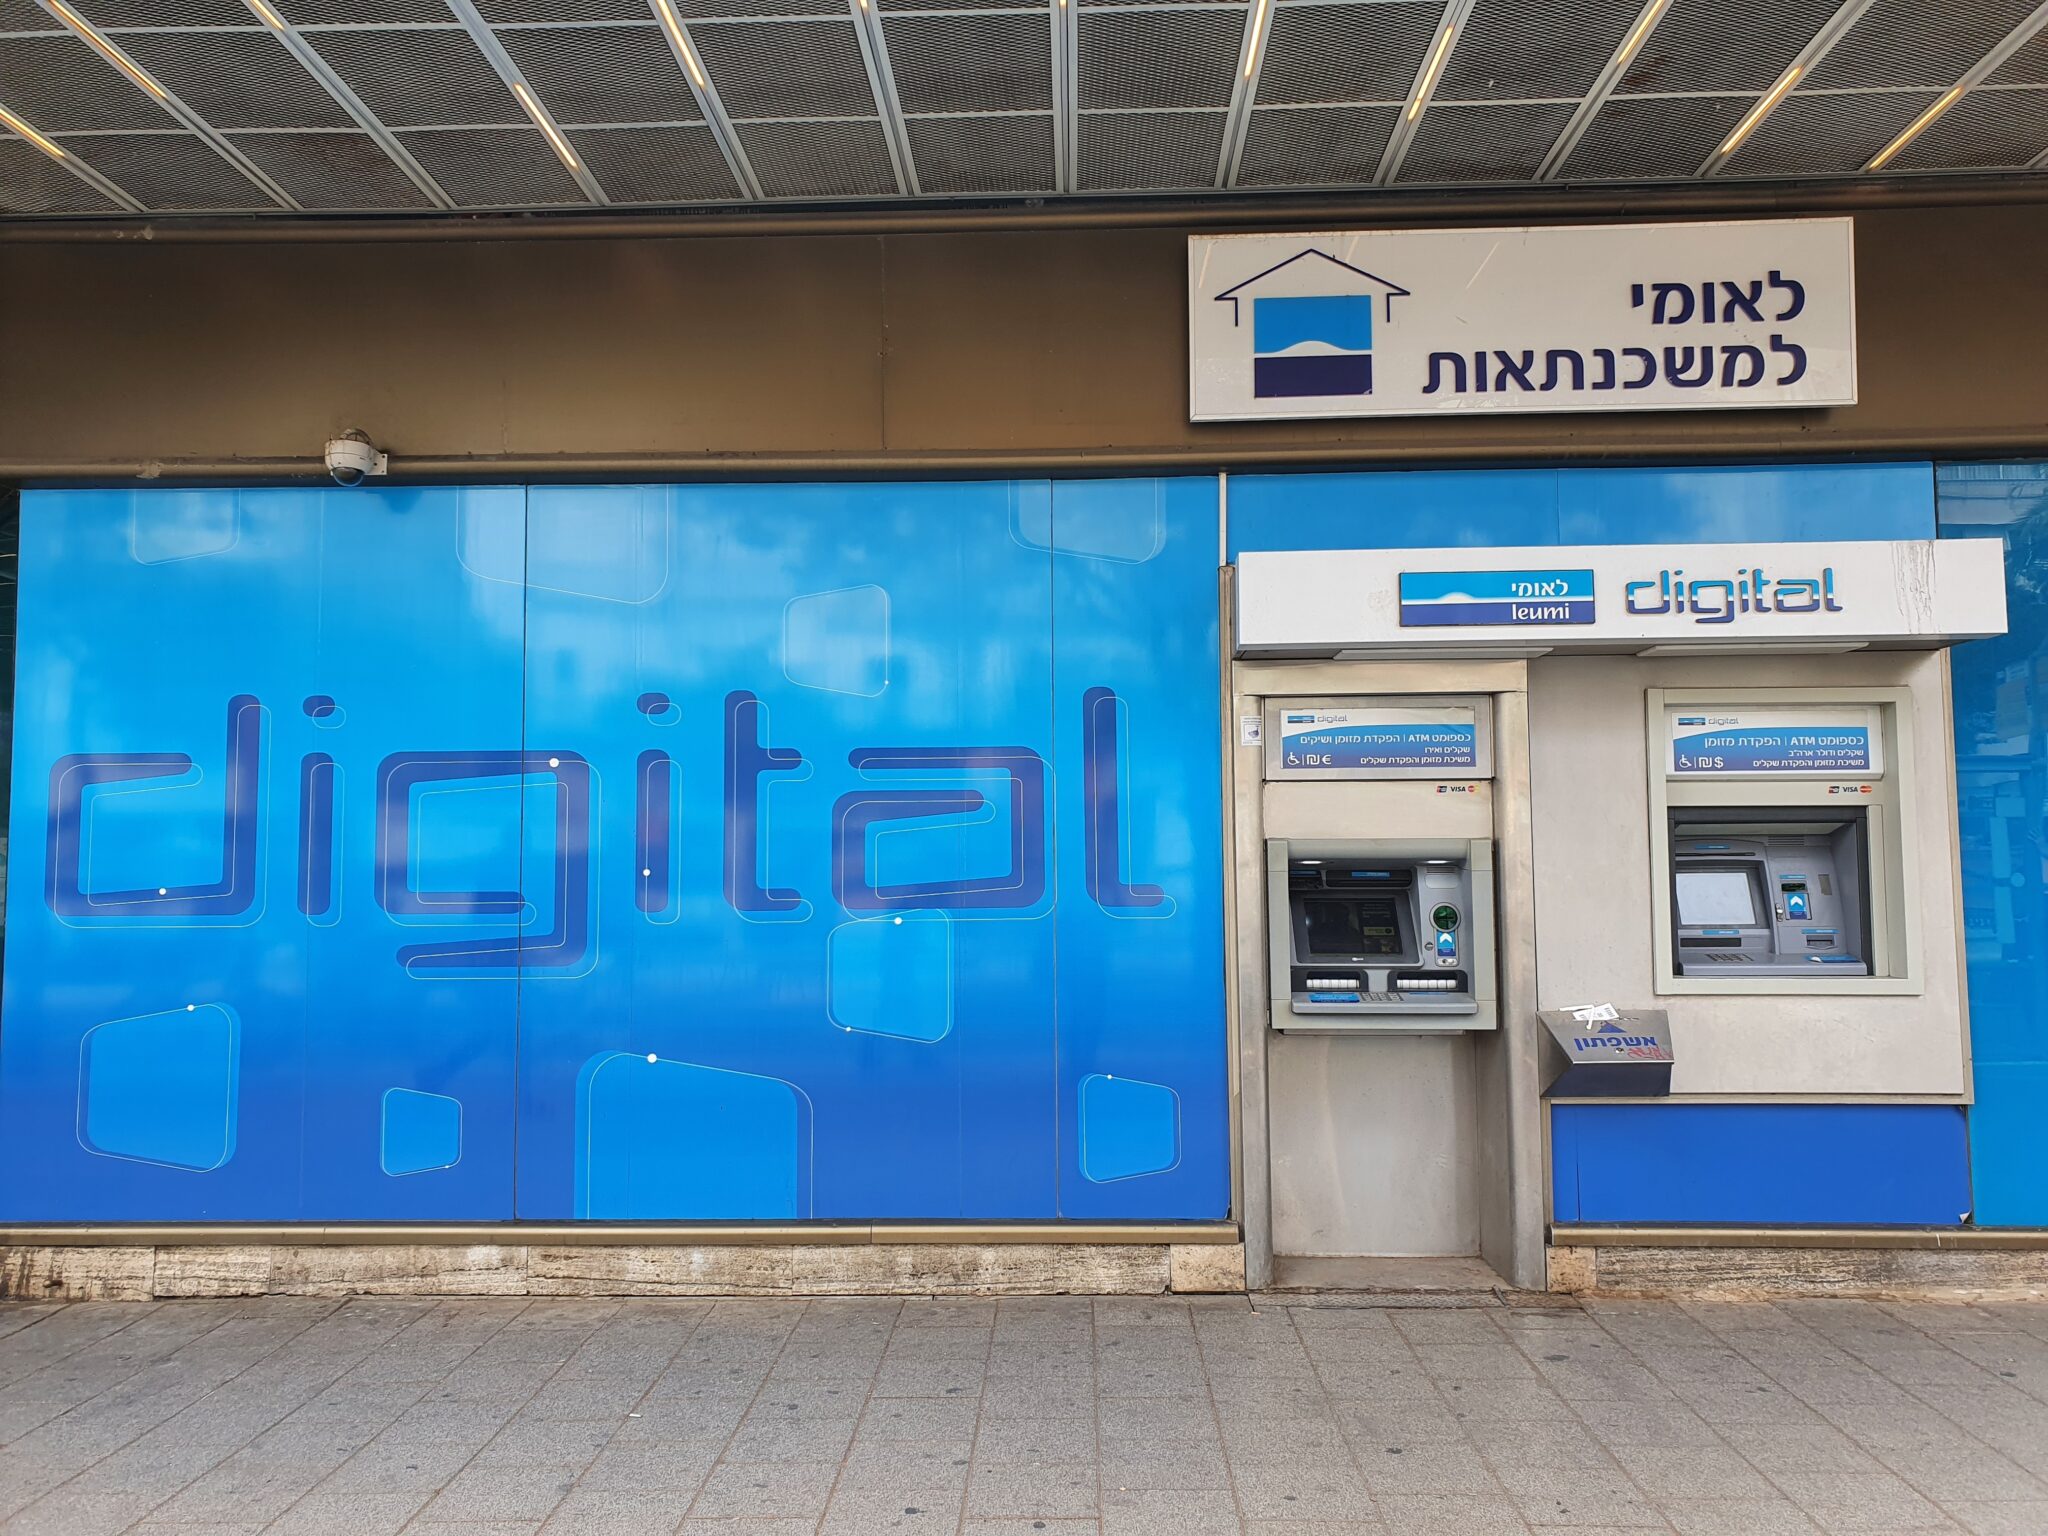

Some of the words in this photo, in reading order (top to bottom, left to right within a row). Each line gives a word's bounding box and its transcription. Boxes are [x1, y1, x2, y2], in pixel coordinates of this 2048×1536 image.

[1631, 270, 1806, 325] לאומי
[1422, 334, 1807, 394] למשכנתאות
[1511, 579, 1569, 597] לאומי
[1625, 567, 1843, 624] digital
[1512, 603, 1570, 619] leumi
[1317, 715, 1348, 723] digital
[1708, 717, 1739, 726] digital
[1300, 735, 1332, 745] ושיקים
[1335, 735, 1361, 745] מזומן
[1364, 734, 1400, 744] הפקדת
[1431, 733, 1471, 743] כספומט
[1704, 738, 1735, 748] מזומן
[1738, 737, 1781, 747] הפקדת
[1790, 737, 1816, 745] ATM
[1818, 736, 1864, 746] כספומט
[1444, 746, 1471, 754] שקלים
[1837, 748, 1864, 757] שקלים
[1714, 756, 1724, 769] $
[45, 686, 1178, 979] digital
[1574, 1036, 1657, 1051] אשפתון
